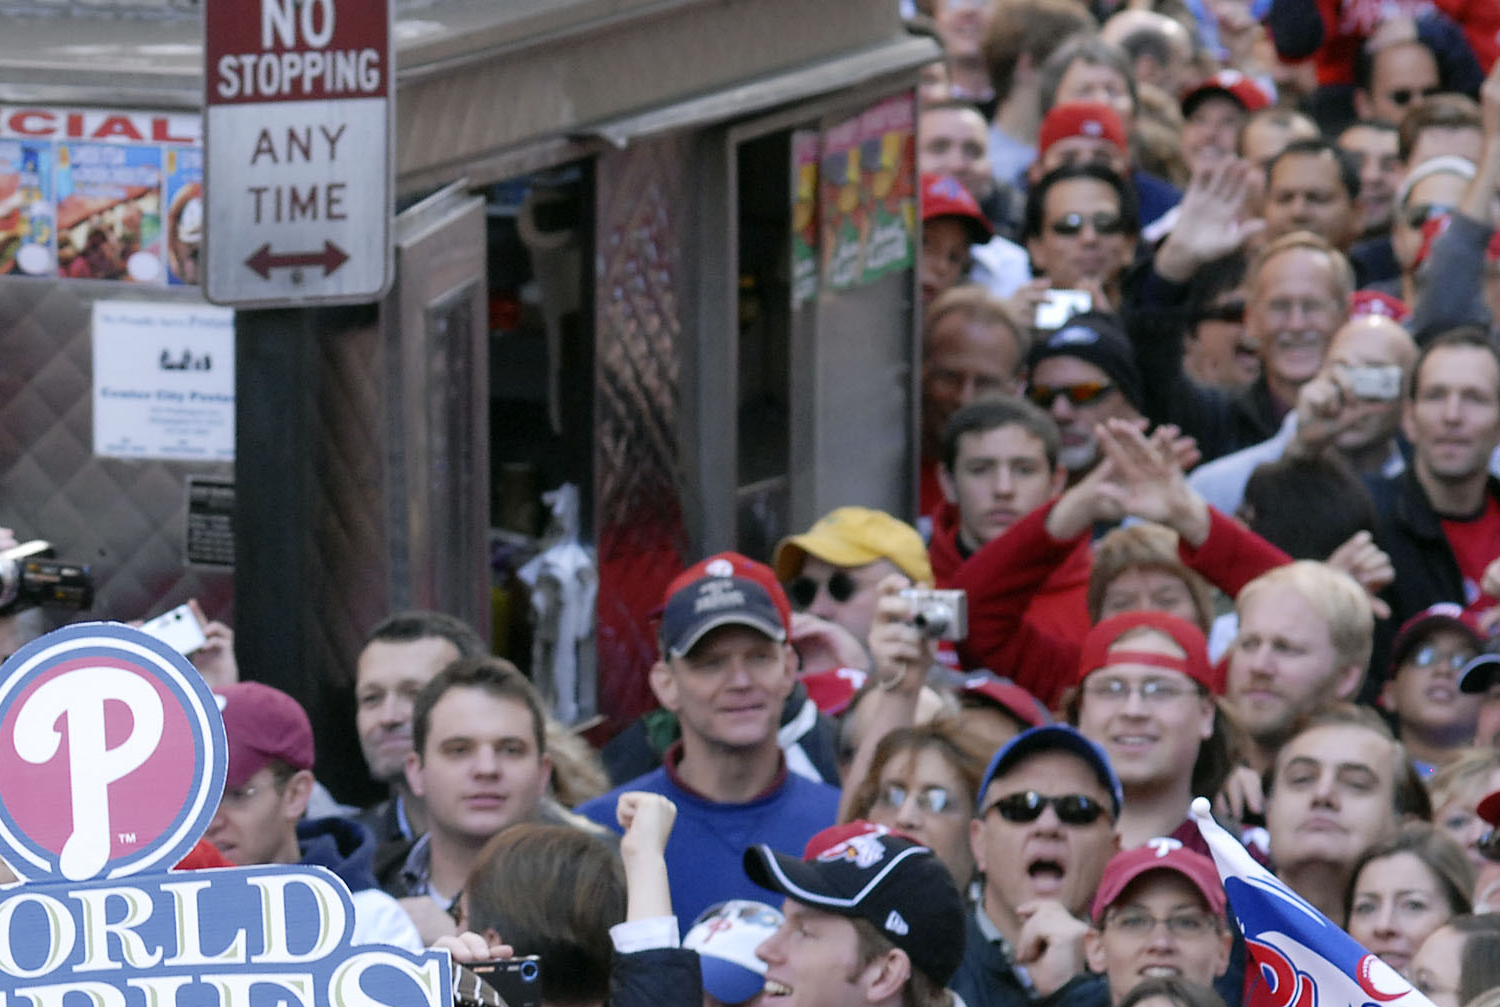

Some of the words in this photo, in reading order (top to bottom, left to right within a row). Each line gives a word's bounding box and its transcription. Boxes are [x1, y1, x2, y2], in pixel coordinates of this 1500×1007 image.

[262, 0, 336, 49] NO
[217, 48, 381, 98] STOPPING
[251, 123, 347, 166] ANY
[247, 182, 349, 225] TIME
[12, 666, 165, 882] P
